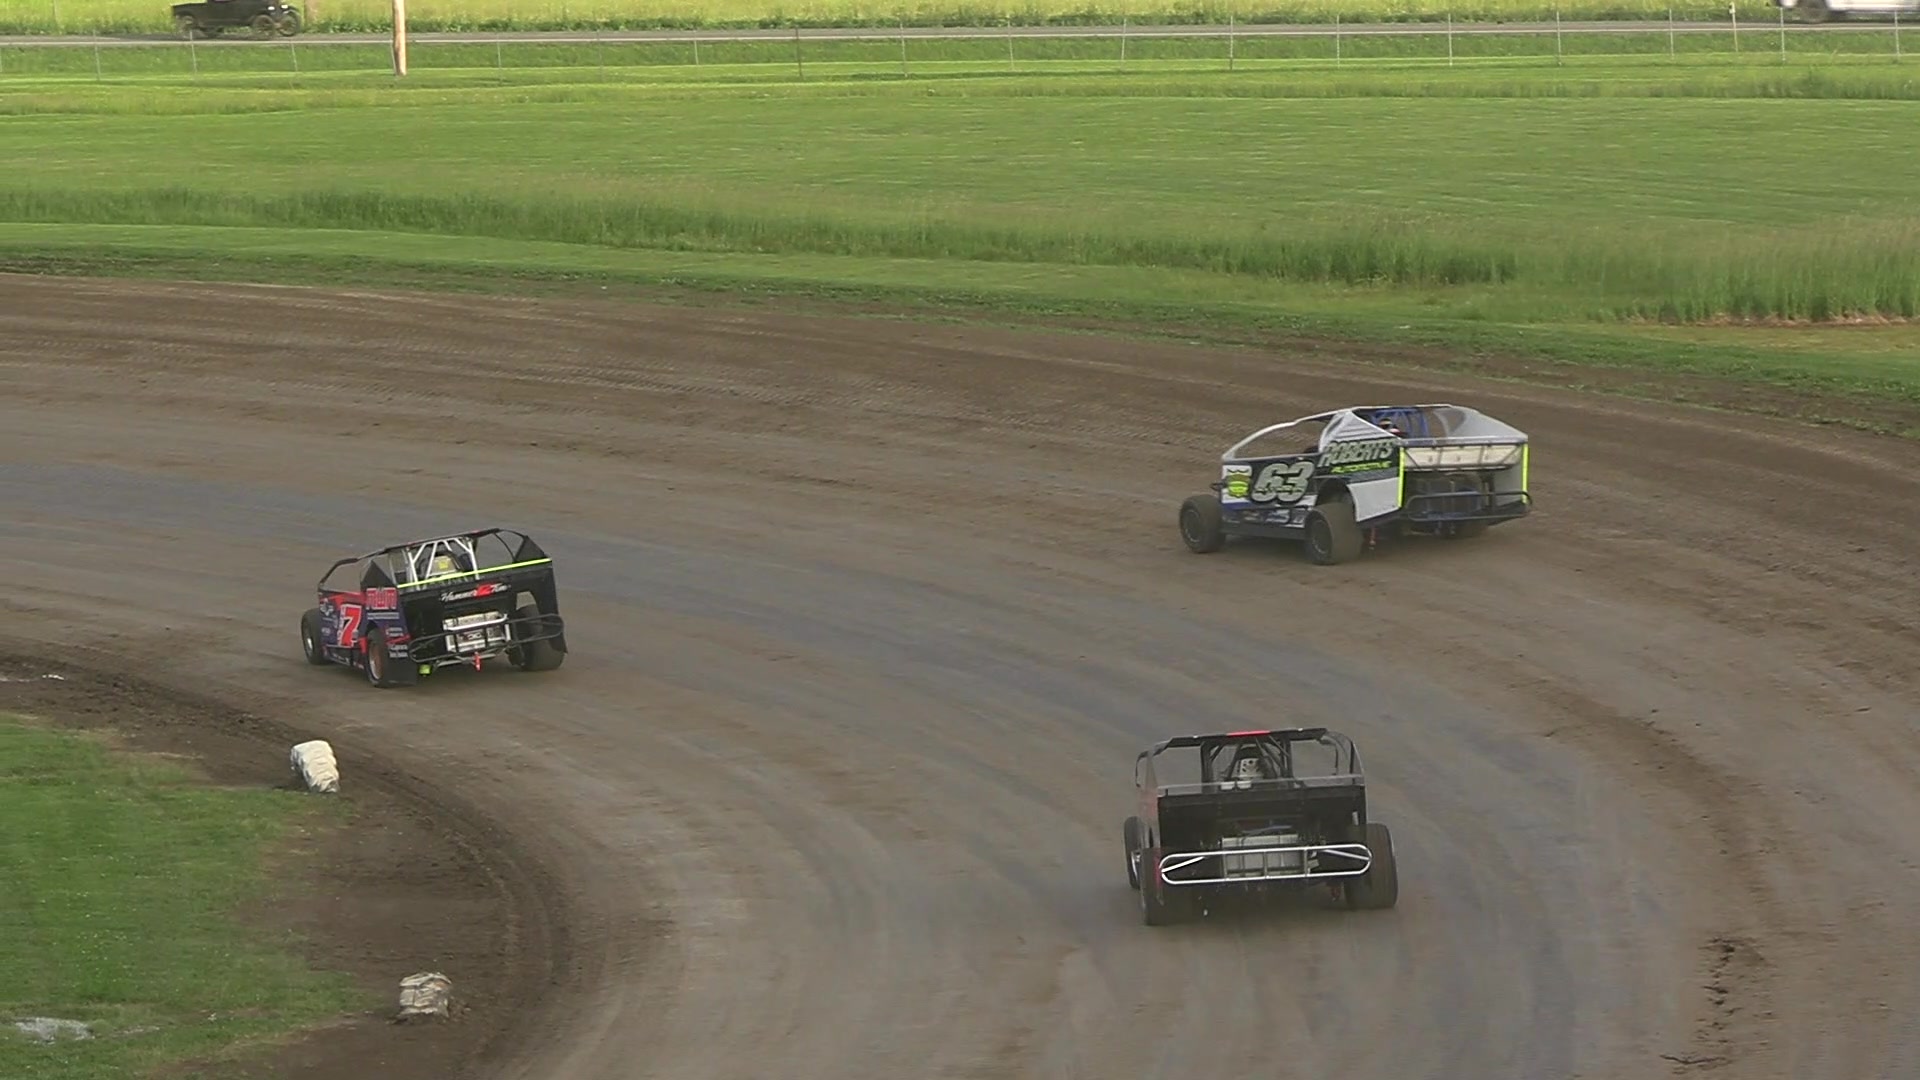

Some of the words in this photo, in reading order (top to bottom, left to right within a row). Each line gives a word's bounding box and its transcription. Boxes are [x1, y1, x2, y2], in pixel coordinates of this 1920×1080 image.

[1317, 438, 1394, 467] ROBERTS
[1251, 461, 1314, 502] 63
[338, 604, 362, 648] 7
